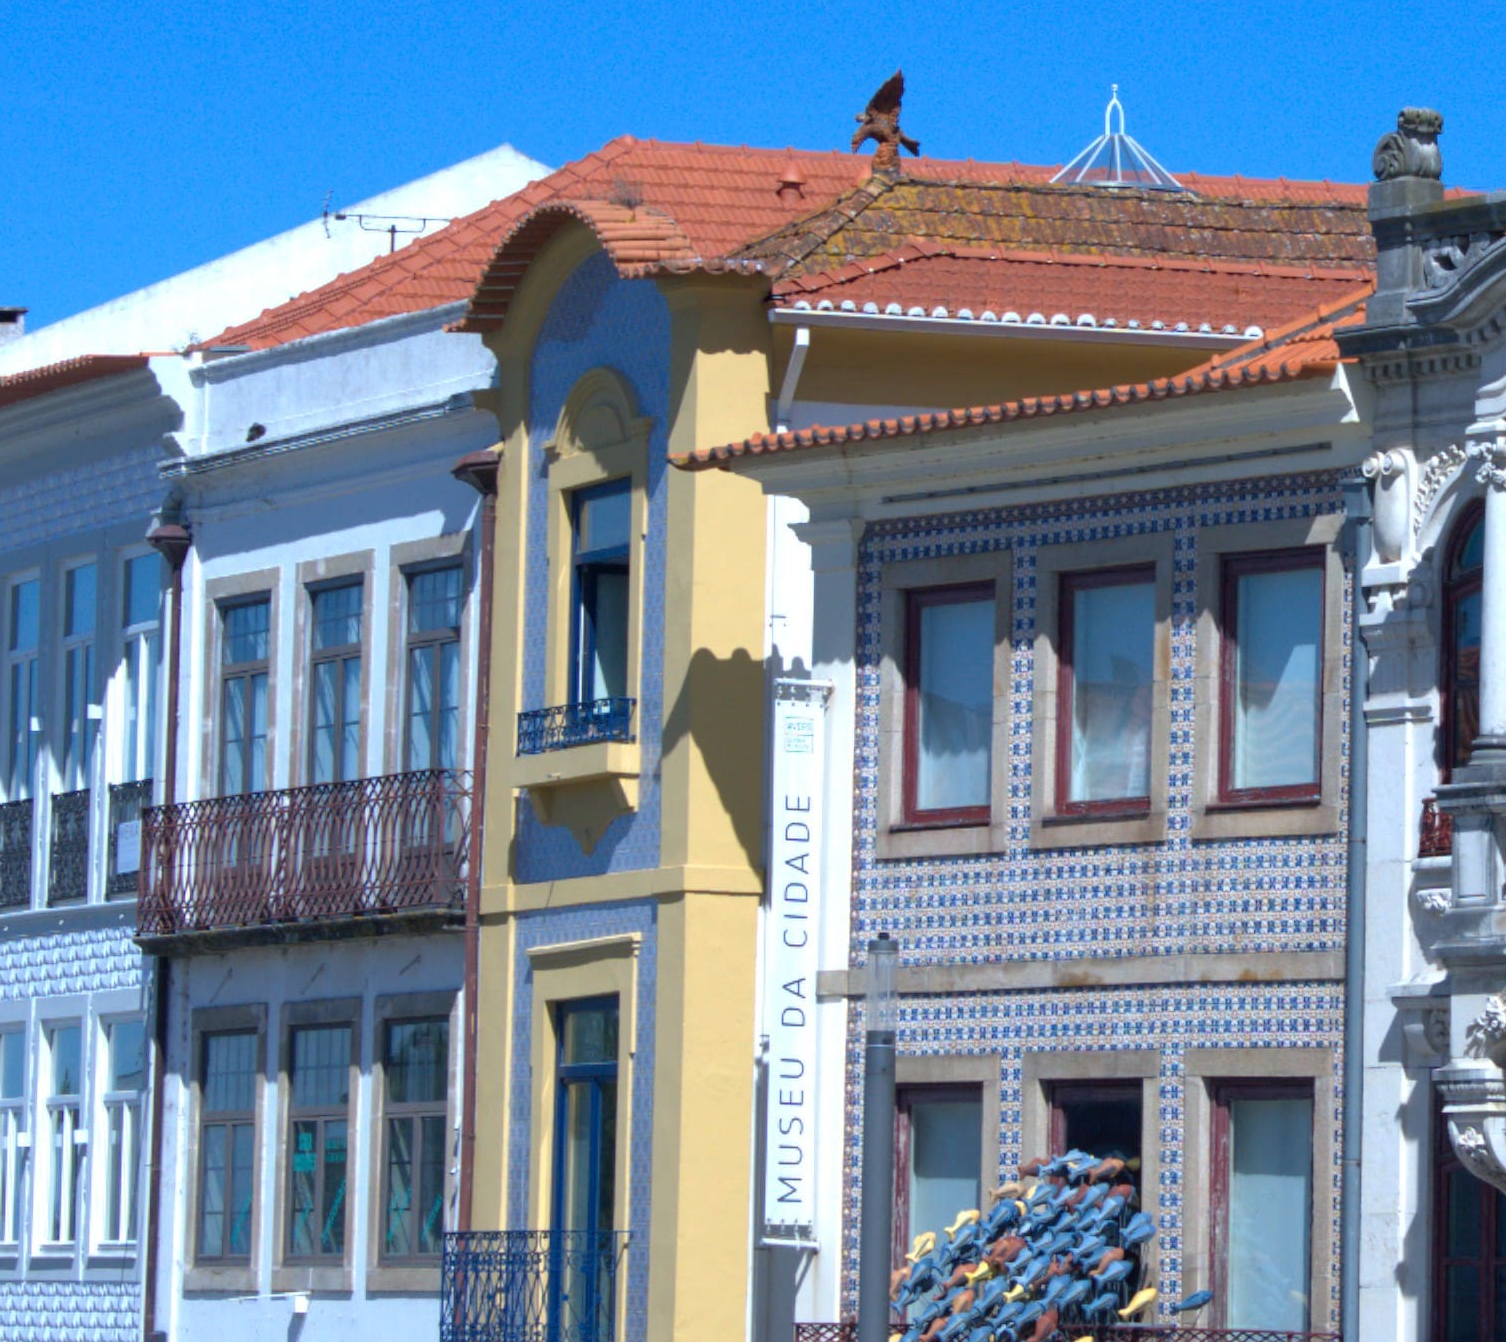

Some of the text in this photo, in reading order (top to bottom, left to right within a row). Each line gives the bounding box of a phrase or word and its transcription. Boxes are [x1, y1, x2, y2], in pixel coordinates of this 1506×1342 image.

[777, 794, 811, 1203] MUSEU DA CIDADE
